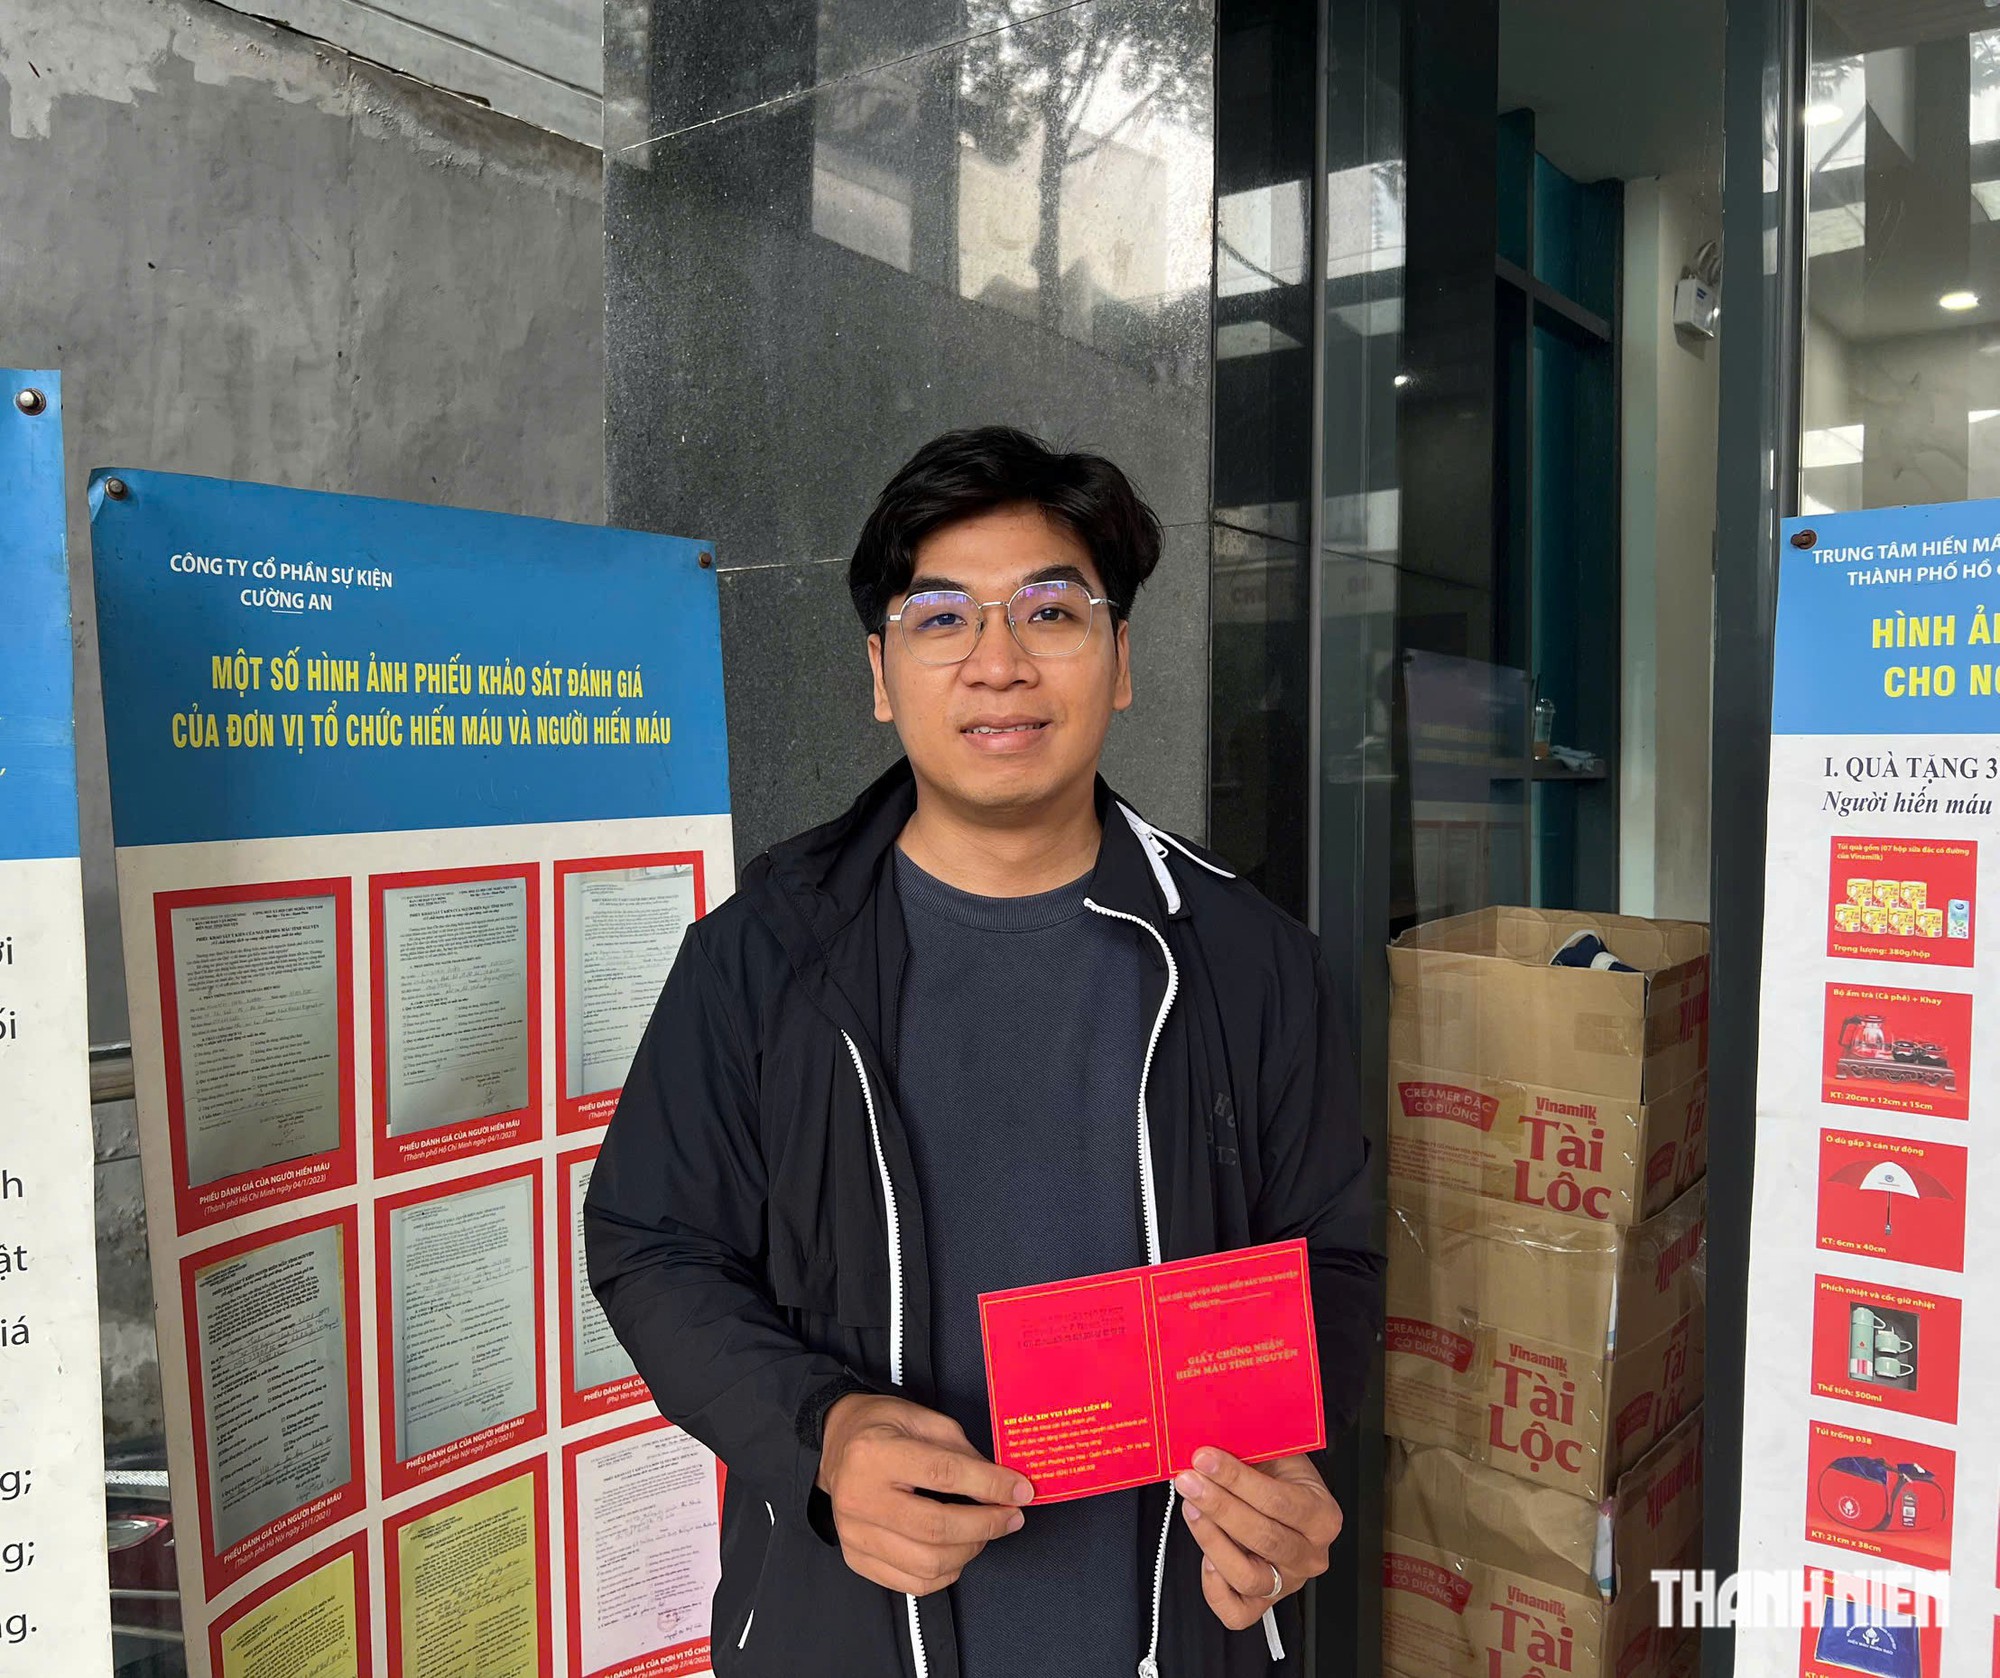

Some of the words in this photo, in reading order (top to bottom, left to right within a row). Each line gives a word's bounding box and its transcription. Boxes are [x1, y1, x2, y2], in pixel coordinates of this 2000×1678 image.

[1812, 546, 1874, 564] TRUNG
[1877, 541, 1917, 559] TÂM
[1922, 535, 1967, 556] HIẾN
[170, 552, 222, 574] CÔNG
[226, 559, 249, 577] TY
[252, 556, 277, 579] CỔ
[280, 560, 328, 583] PHẦN
[331, 566, 353, 589] SỰ
[357, 567, 393, 591] KIỆN
[1847, 567, 1912, 586] THÀNH
[1917, 560, 1958, 582] PHỐ
[1963, 558, 1992, 579] HỒ
[240, 587, 304, 609] CƯỜNG
[308, 594, 333, 611] AN
[1872, 609, 1956, 649] HÌNH
[212, 648, 263, 698] MỘT
[270, 646, 301, 692] SỐ
[307, 651, 360, 692] HÌNH
[366, 651, 408, 693] ẢNH
[414, 653, 471, 695] PHIẾU
[478, 657, 526, 697] KHẢO
[531, 660, 563, 697] SÁT
[567, 662, 612, 698] ĐÁNH
[617, 664, 643, 698] GIÁ
[1884, 665, 1956, 698] CHO
[172, 702, 220, 748] CỦA
[226, 709, 274, 747] ĐƠN
[281, 714, 303, 754] VỊ
[311, 700, 339, 747] TỔ
[346, 707, 403, 746] CHỨC
[410, 704, 455, 746] HIẾN
[461, 708, 502, 746] MÁU
[508, 708, 532, 746] VÀ
[536, 709, 588, 746] NGƯỜI
[593, 706, 630, 745] HIẾN
[636, 710, 671, 745] MÁU
[1823, 757, 1839, 777] I.
[1846, 751, 1899, 782] QUÀ
[1906, 753, 1979, 784] TẶNG
[1822, 791, 1888, 817] Người
[1893, 786, 1938, 813] hiến
[1945, 793, 1992, 815] máu
[1833, 944, 1858, 953] Trọng
[1920, 996, 1942, 1006] Khay
[1404, 1087, 1461, 1103] CREAMER
[1463, 1094, 1492, 1112] ĐẶC
[1414, 1099, 1433, 1113] CÓ
[1535, 1096, 1598, 1122] Vinamilk
[1830, 1091, 1844, 1099] KT:
[1845, 1092, 1869, 1102] 20cm
[1877, 1096, 1901, 1106] 12cm
[1909, 1101, 1933, 1110] 15cm
[399, 1141, 420, 1153] PHIẾU
[420, 1136, 440, 1148] ĐÁNH
[441, 1133, 454, 1143] GIÁ
[454, 1130, 468, 1141] CỦA
[490, 1122, 505, 1133] HIẾN
[505, 1119, 520, 1129] MÁU
[1518, 1115, 1605, 1173] Tài
[1901, 1145, 1924, 1156] động
[199, 1191, 220, 1205] PHIẾU
[220, 1186, 241, 1199] ĐÁNH
[241, 1180, 254, 1192] GIÁ
[255, 1176, 270, 1188] CỦA
[270, 1170, 295, 1184] NGƯỜI
[295, 1164, 312, 1178] HIẾN
[313, 1162, 330, 1173] MÁU
[1821, 1237, 1835, 1245] KT:
[1836, 1239, 1855, 1248] 6cm
[1863, 1243, 1887, 1253] 40cm
[1820, 1282, 1844, 1293] Phích
[1846, 1287, 1868, 1298] nhiệt
[1869, 1291, 1880, 1299] và
[1912, 1299, 1936, 1310] nhiệt
[1188, 1350, 1214, 1365] GIẤY
[1203, 1362, 1227, 1374] MÁU
[1509, 1343, 1568, 1374] Vinamilk
[1493, 1359, 1576, 1426] Tài
[1855, 1391, 1882, 1402] 500ml
[1488, 1403, 1583, 1473] Lộc
[1815, 1426, 1829, 1436] Túi
[405, 1457, 426, 1469] PHIẾU
[427, 1449, 446, 1461] ĐÁNH
[446, 1443, 459, 1453] GIÁ
[459, 1438, 473, 1448] CỦA
[223, 1547, 242, 1564] PHIẾU
[261, 1527, 273, 1539] GIÁ
[273, 1520, 287, 1533] CỦA
[1811, 1531, 1825, 1540] KT:
[1826, 1533, 1849, 1544] 21cm
[1507, 1585, 1566, 1620] Vinamilk
[1490, 1602, 1574, 1673] Tài
